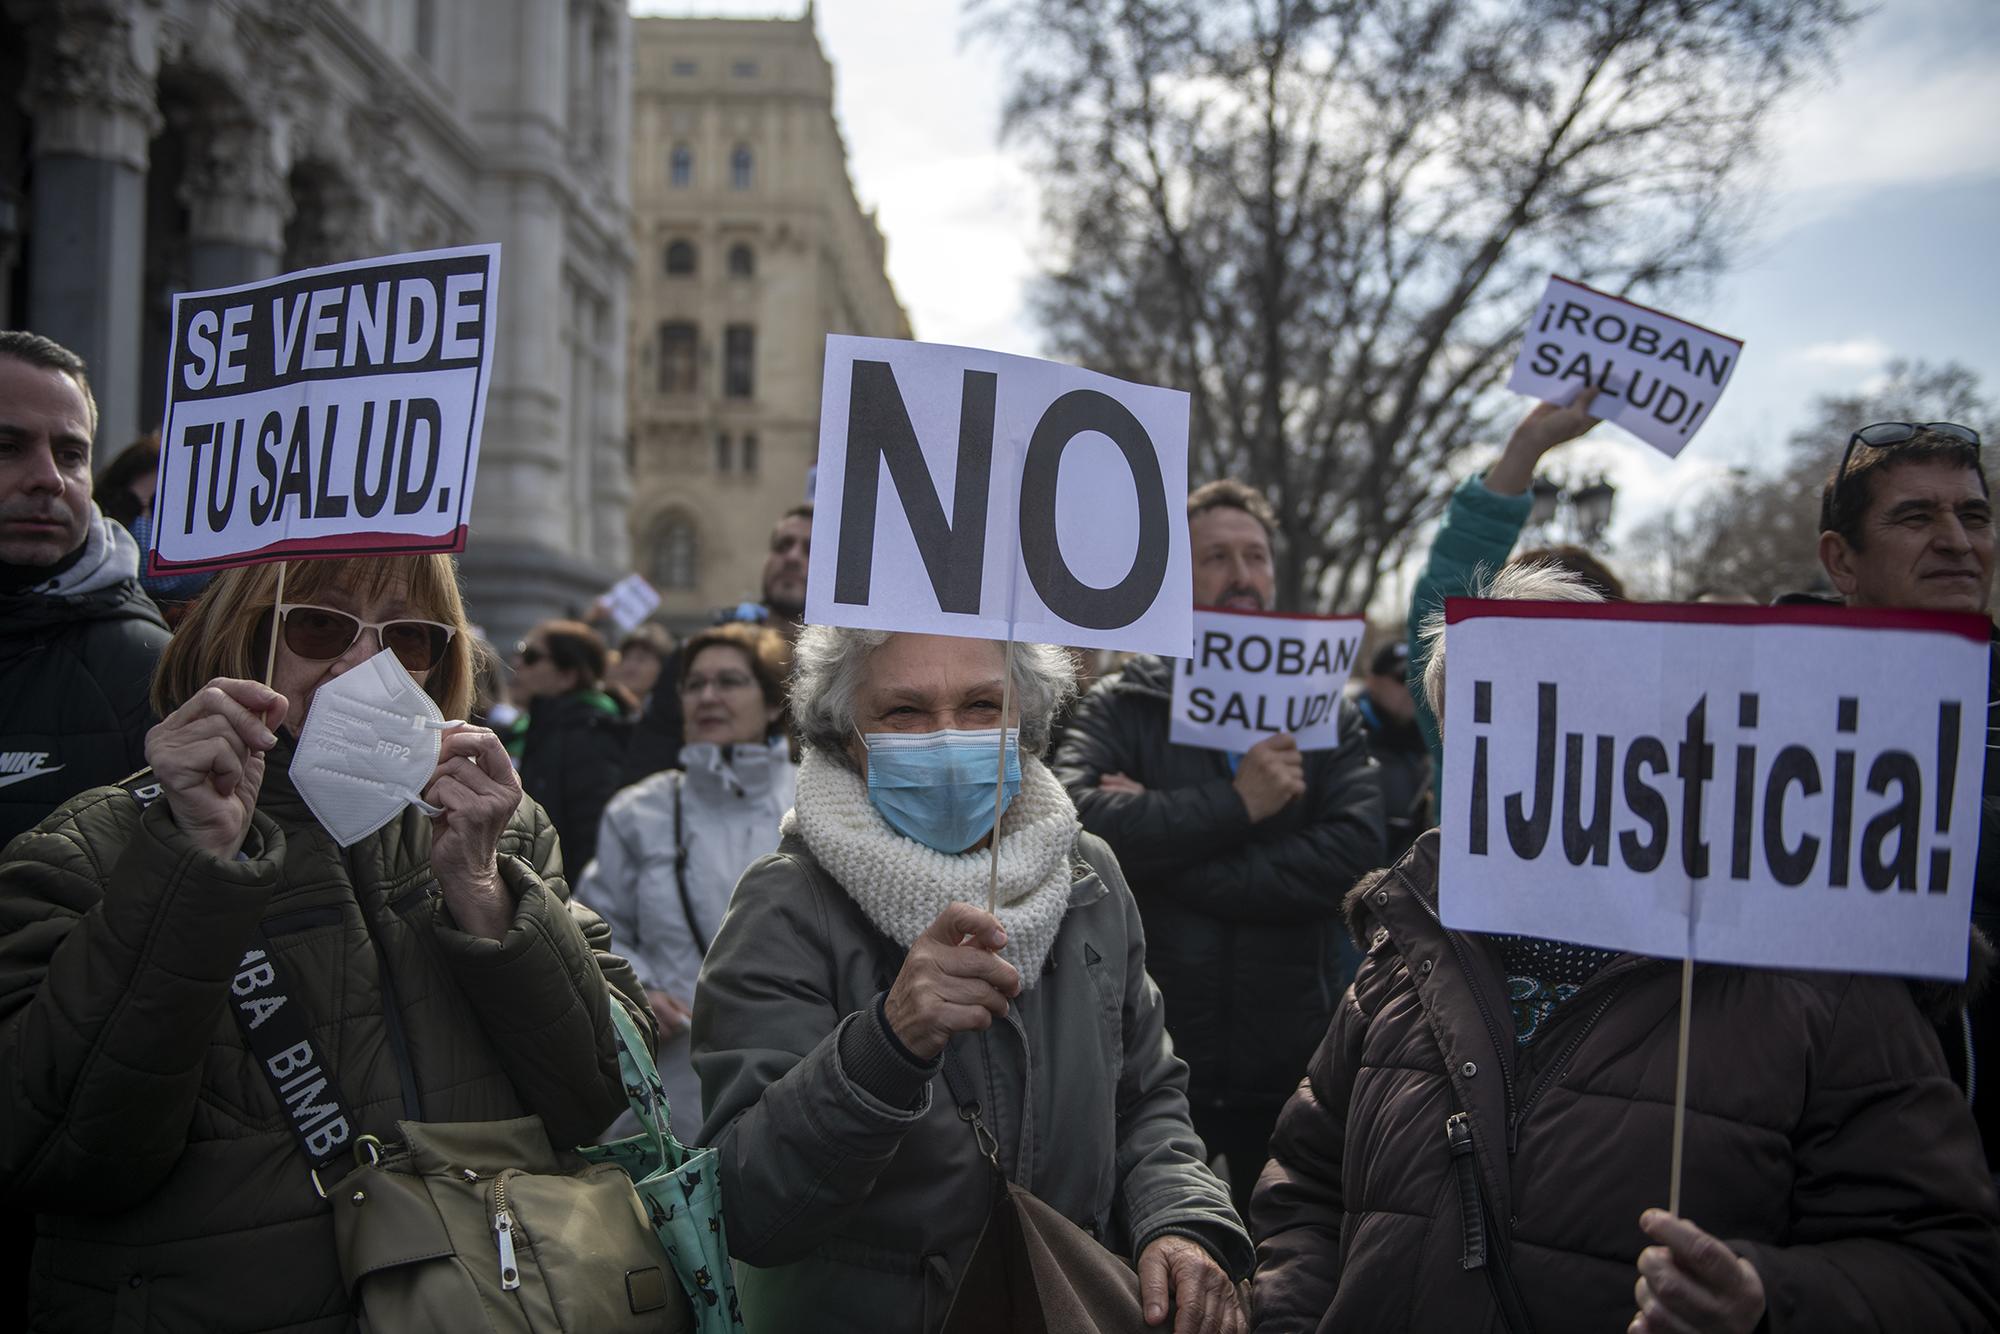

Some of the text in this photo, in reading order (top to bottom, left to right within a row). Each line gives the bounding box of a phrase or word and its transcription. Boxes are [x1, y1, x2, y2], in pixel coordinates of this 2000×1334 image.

[182, 272, 485, 392] SE VENDE
[1538, 300, 1731, 387] ¡ROBAN
[1529, 342, 1705, 436] SALUD!
[183, 397, 449, 535] TU SALUD.
[833, 358, 1170, 631] NO
[0, 752, 50, 773] NIKE
[375, 739, 411, 761] FFP2
[1186, 687, 1339, 733] SALUD!
[1468, 680, 1962, 895] ¡Justicia!
[267, 1039, 350, 1160] BIMB
